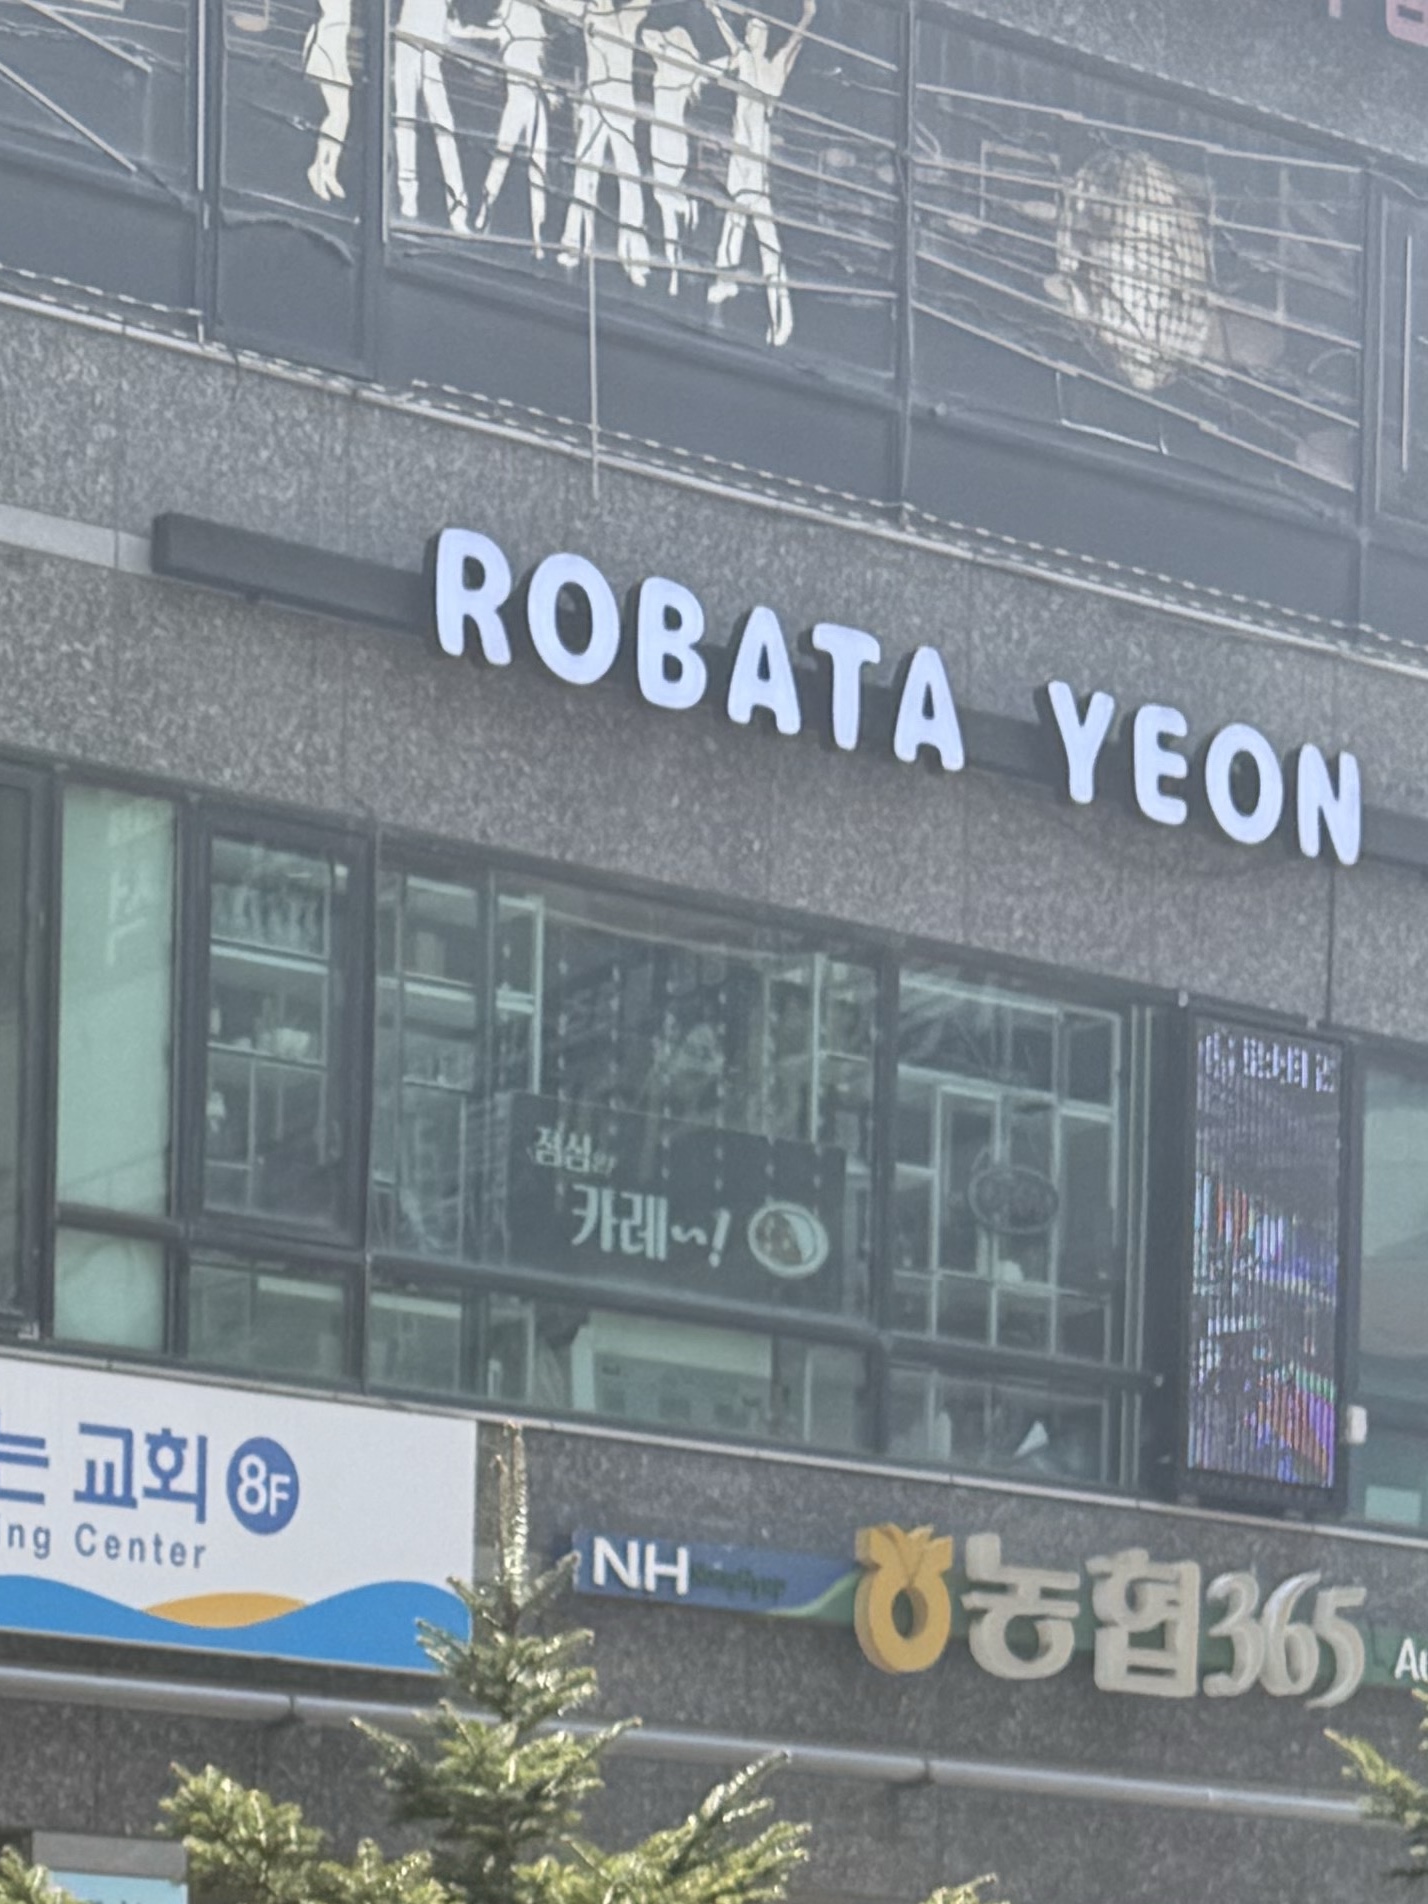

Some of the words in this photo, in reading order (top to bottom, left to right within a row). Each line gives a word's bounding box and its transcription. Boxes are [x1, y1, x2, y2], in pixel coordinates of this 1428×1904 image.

[435, 527, 965, 772] ROBATA
[1049, 679, 1361, 866] YEON
[73, 1422, 209, 1524] 교회
[236, 1454, 292, 1516] 8F
[74, 1522, 208, 1569] Center
[593, 1536, 690, 1597] NH
